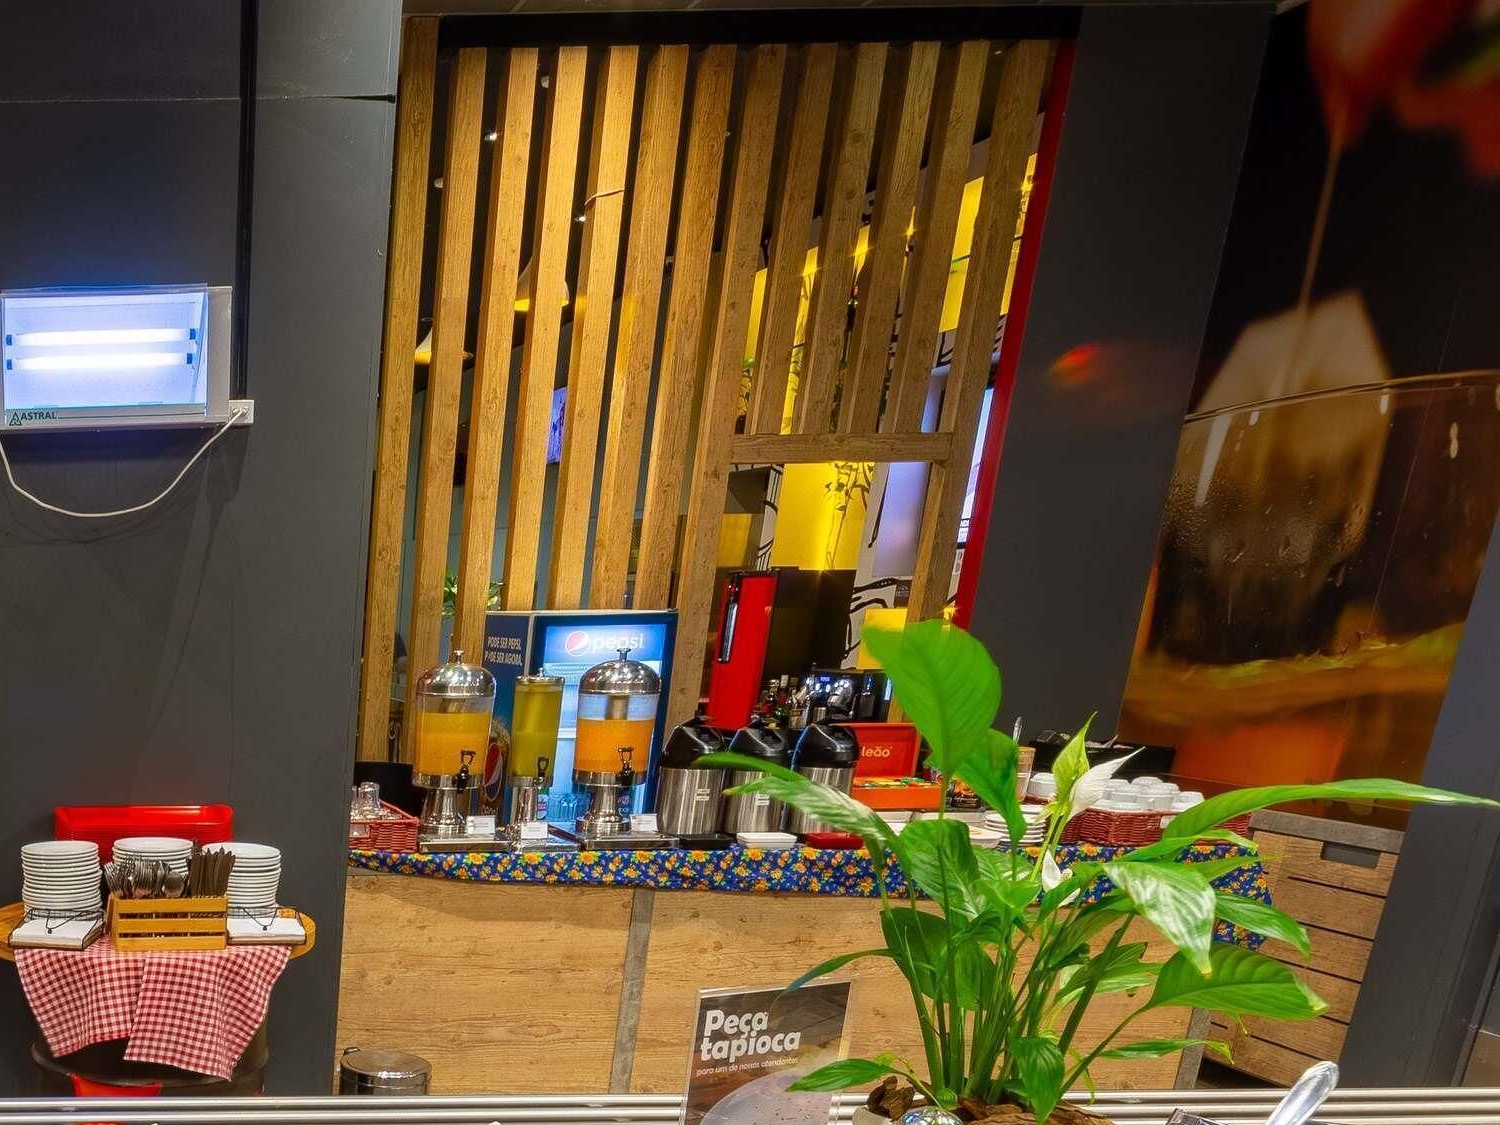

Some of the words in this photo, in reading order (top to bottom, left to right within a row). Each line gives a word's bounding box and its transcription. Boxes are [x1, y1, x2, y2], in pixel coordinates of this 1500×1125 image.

[20, 411, 57, 420] ASTRAL
[591, 633, 645, 652] pepsi
[861, 746, 890, 757] leão
[703, 1009, 769, 1038] Peça
[700, 1031, 802, 1062] tapioca
[696, 1067, 715, 1078] para
[715, 1065, 727, 1073] um
[728, 1063, 738, 1072] de
